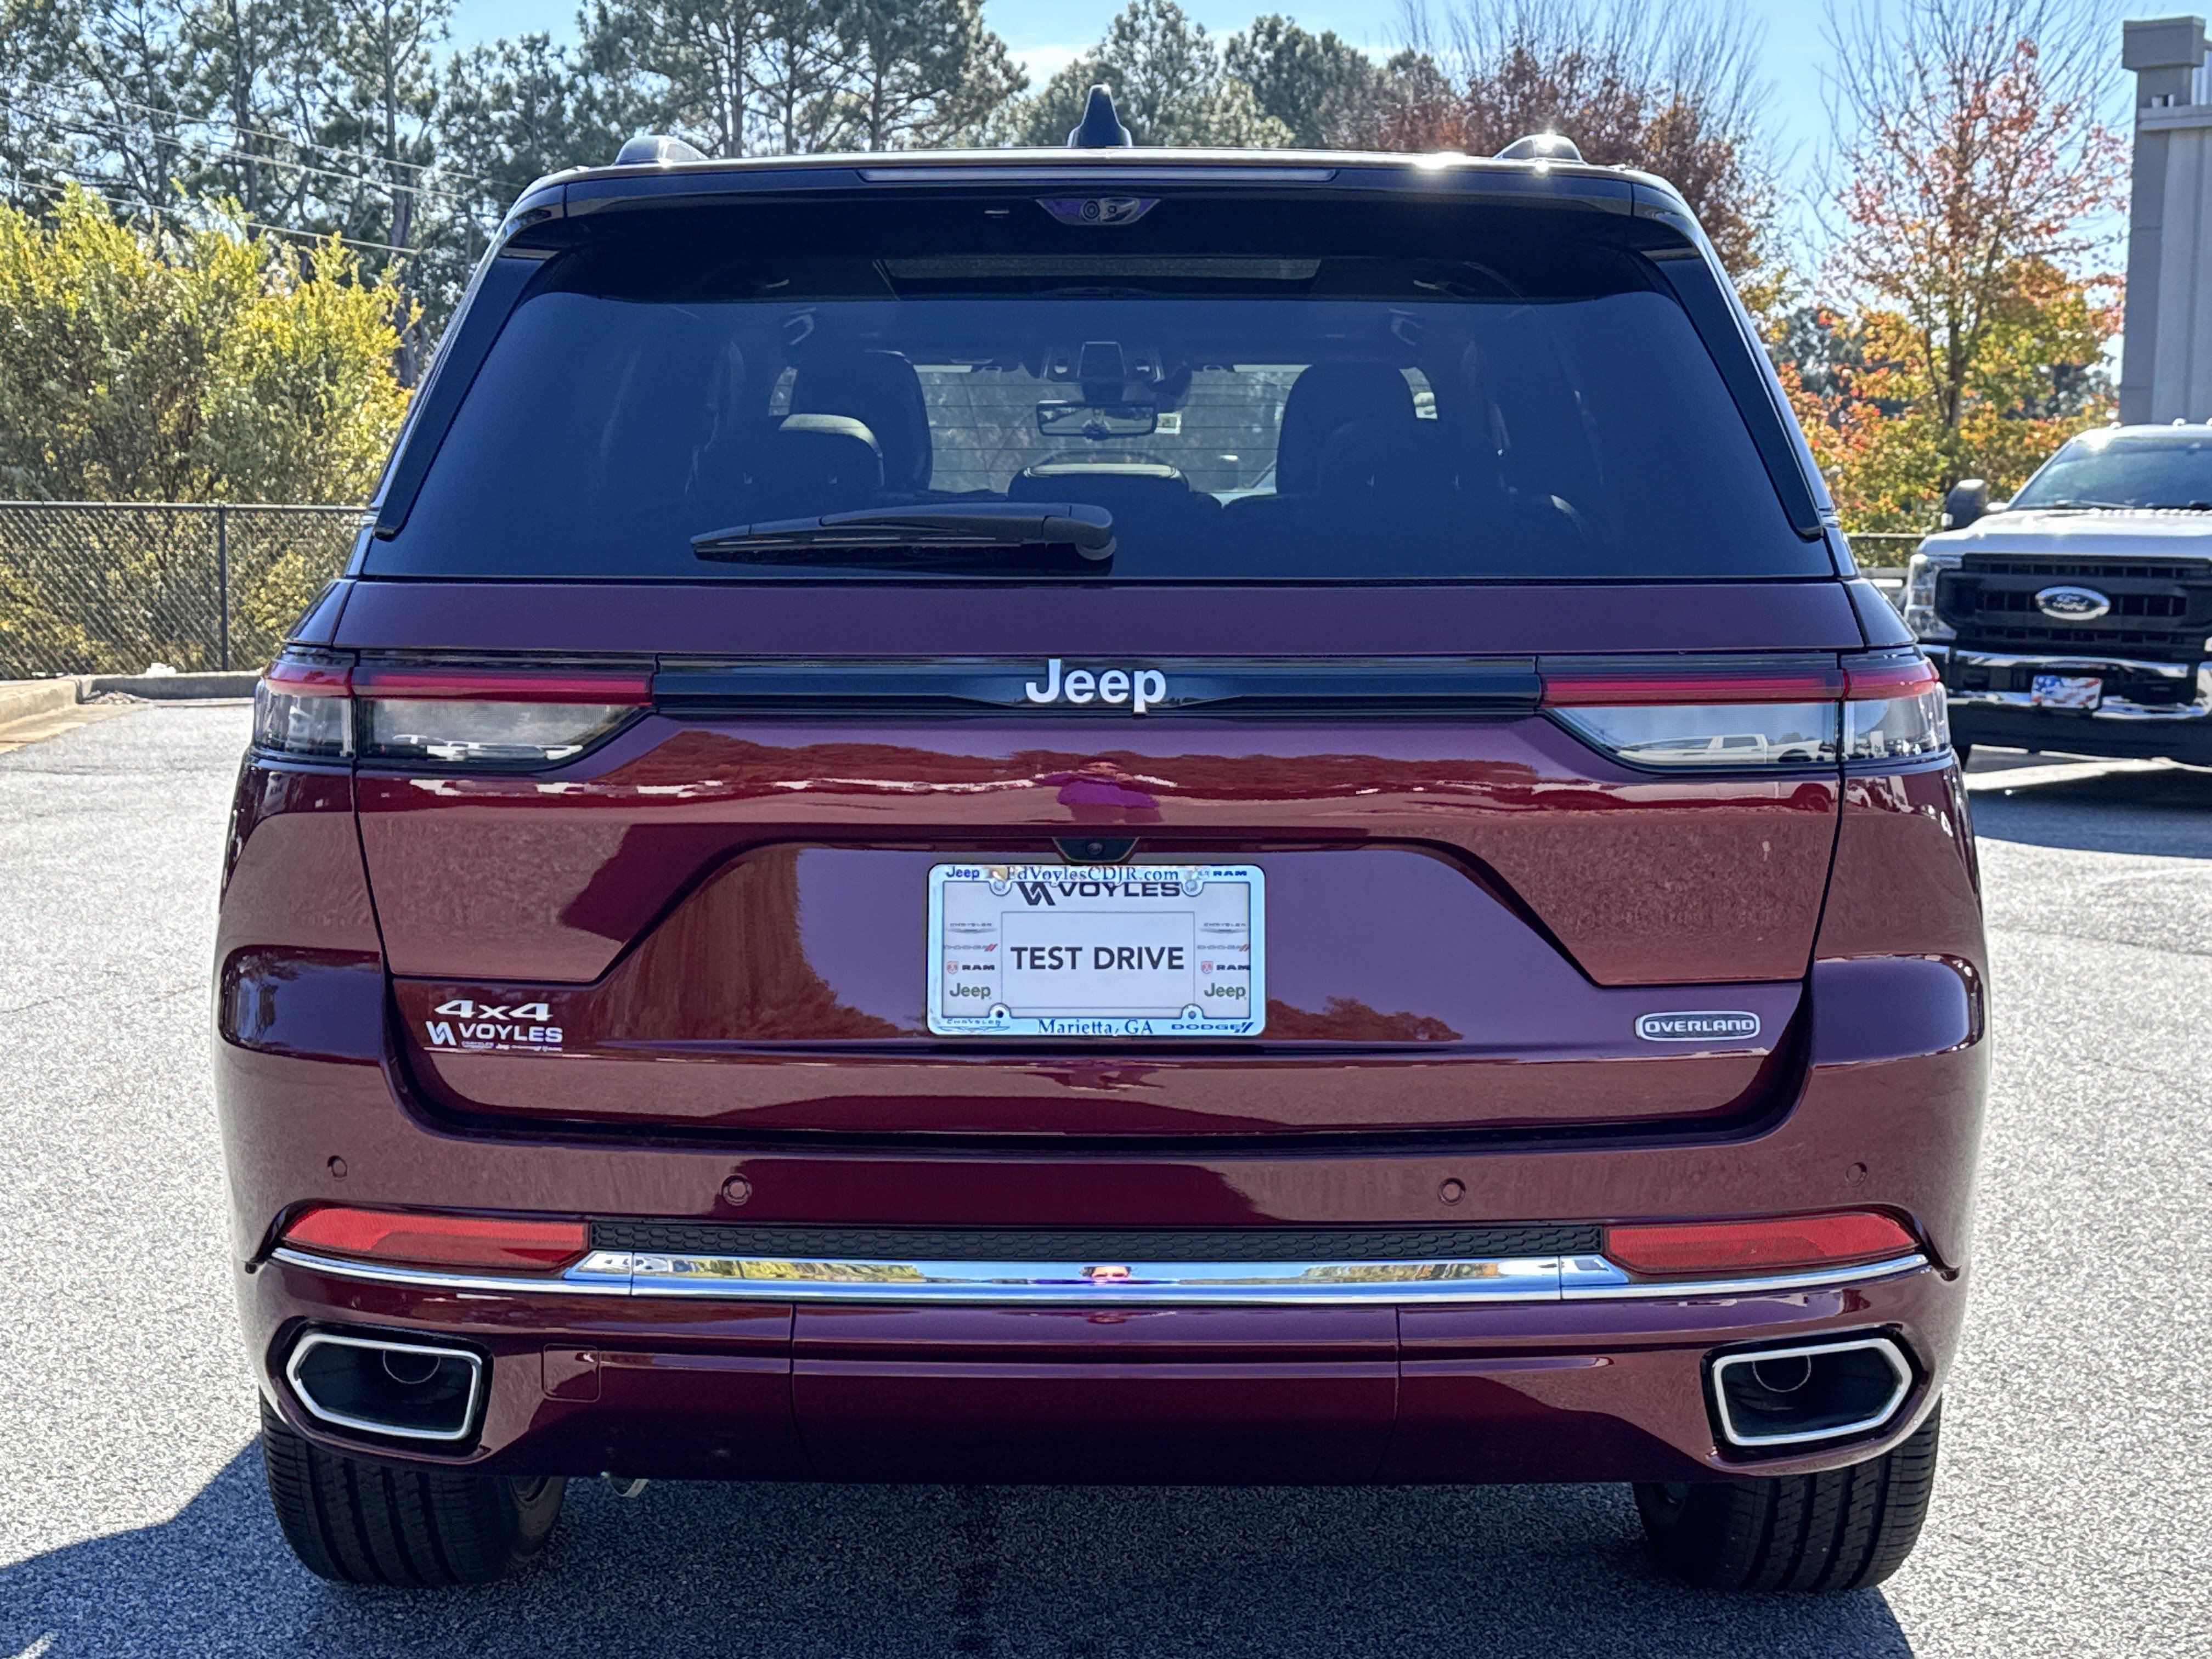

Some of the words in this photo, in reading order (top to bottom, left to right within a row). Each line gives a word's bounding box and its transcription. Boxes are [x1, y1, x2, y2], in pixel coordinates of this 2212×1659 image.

[1025, 658, 1166, 713] Jeep
[946, 866, 980, 879] Jeep
[1058, 882, 1180, 897] VOYLES
[1010, 946, 1082, 970] TEST
[1094, 946, 1184, 970] DRIVE
[949, 983, 991, 1000] Jeep
[1204, 983, 1246, 1000] Jeep
[435, 1000, 553, 1021] 4x4
[458, 1023, 563, 1042] VOYLES
[1038, 1018, 1119, 1036] Marietta,
[1125, 1019, 1153, 1034] GA
[1645, 1019, 1754, 1033] OVERLAND
